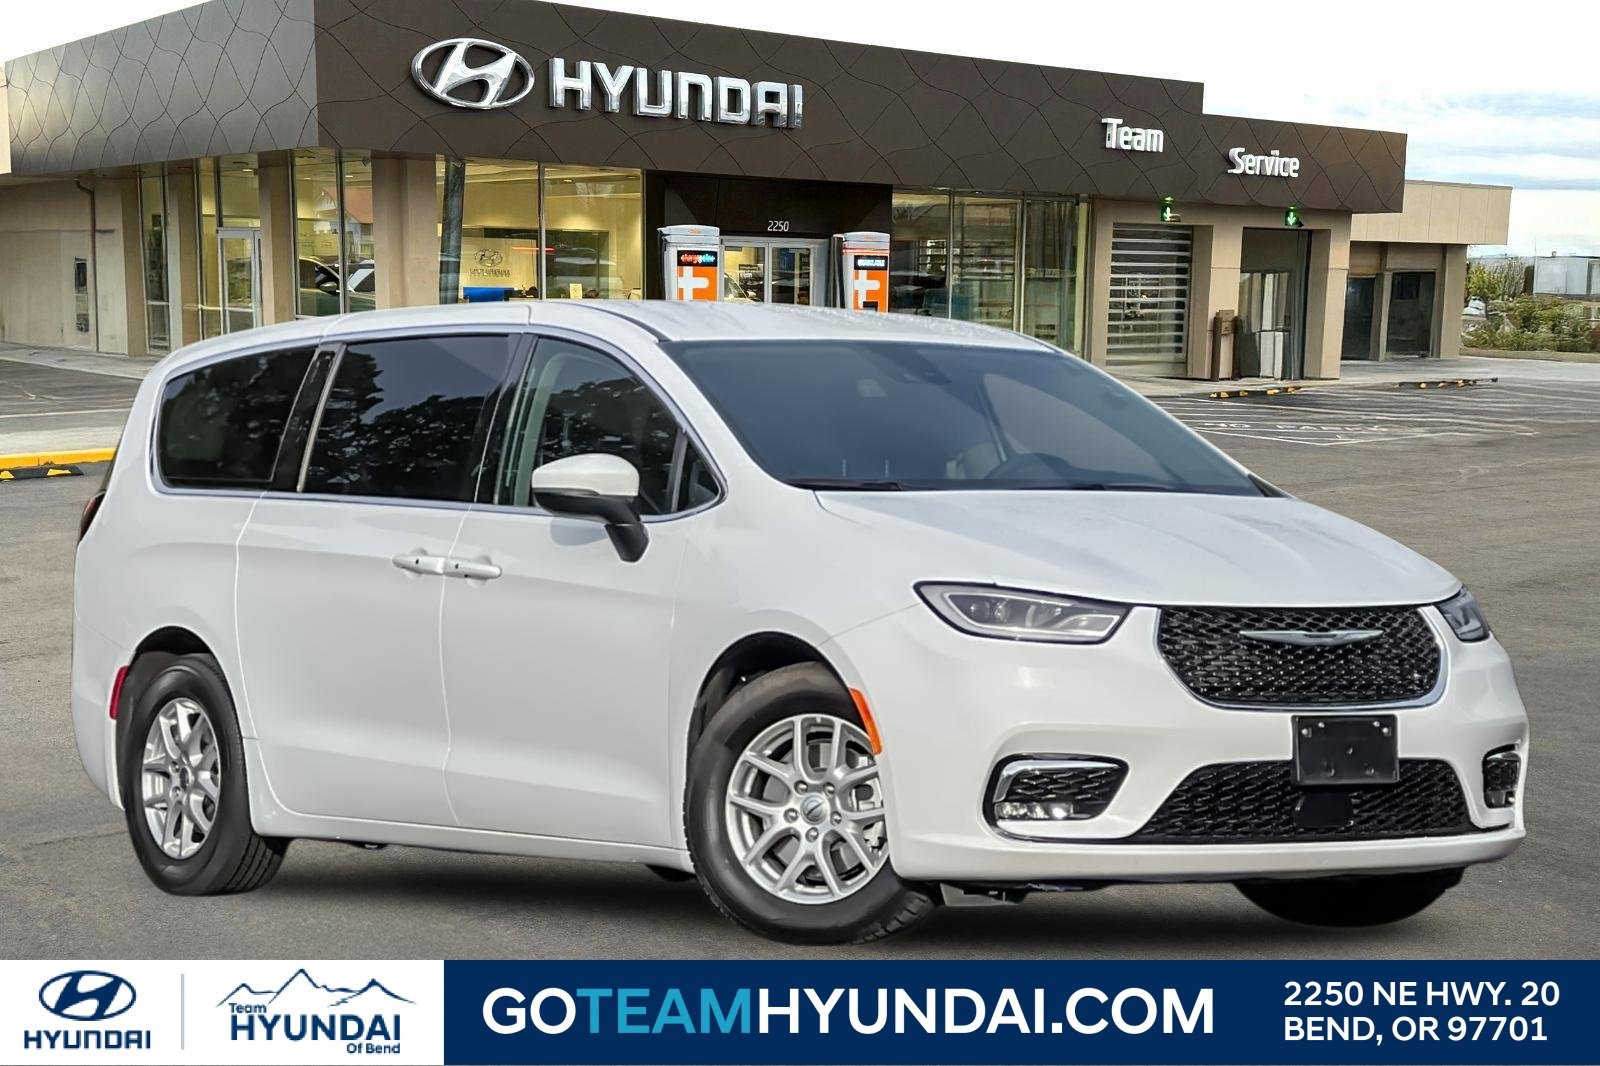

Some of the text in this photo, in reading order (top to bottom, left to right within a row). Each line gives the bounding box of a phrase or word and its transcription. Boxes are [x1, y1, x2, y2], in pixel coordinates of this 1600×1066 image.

[549, 57, 803, 129] HYUNDAI
[1102, 117, 1165, 153] Team
[1227, 147, 1300, 178] Service
[767, 220, 790, 232] 2250
